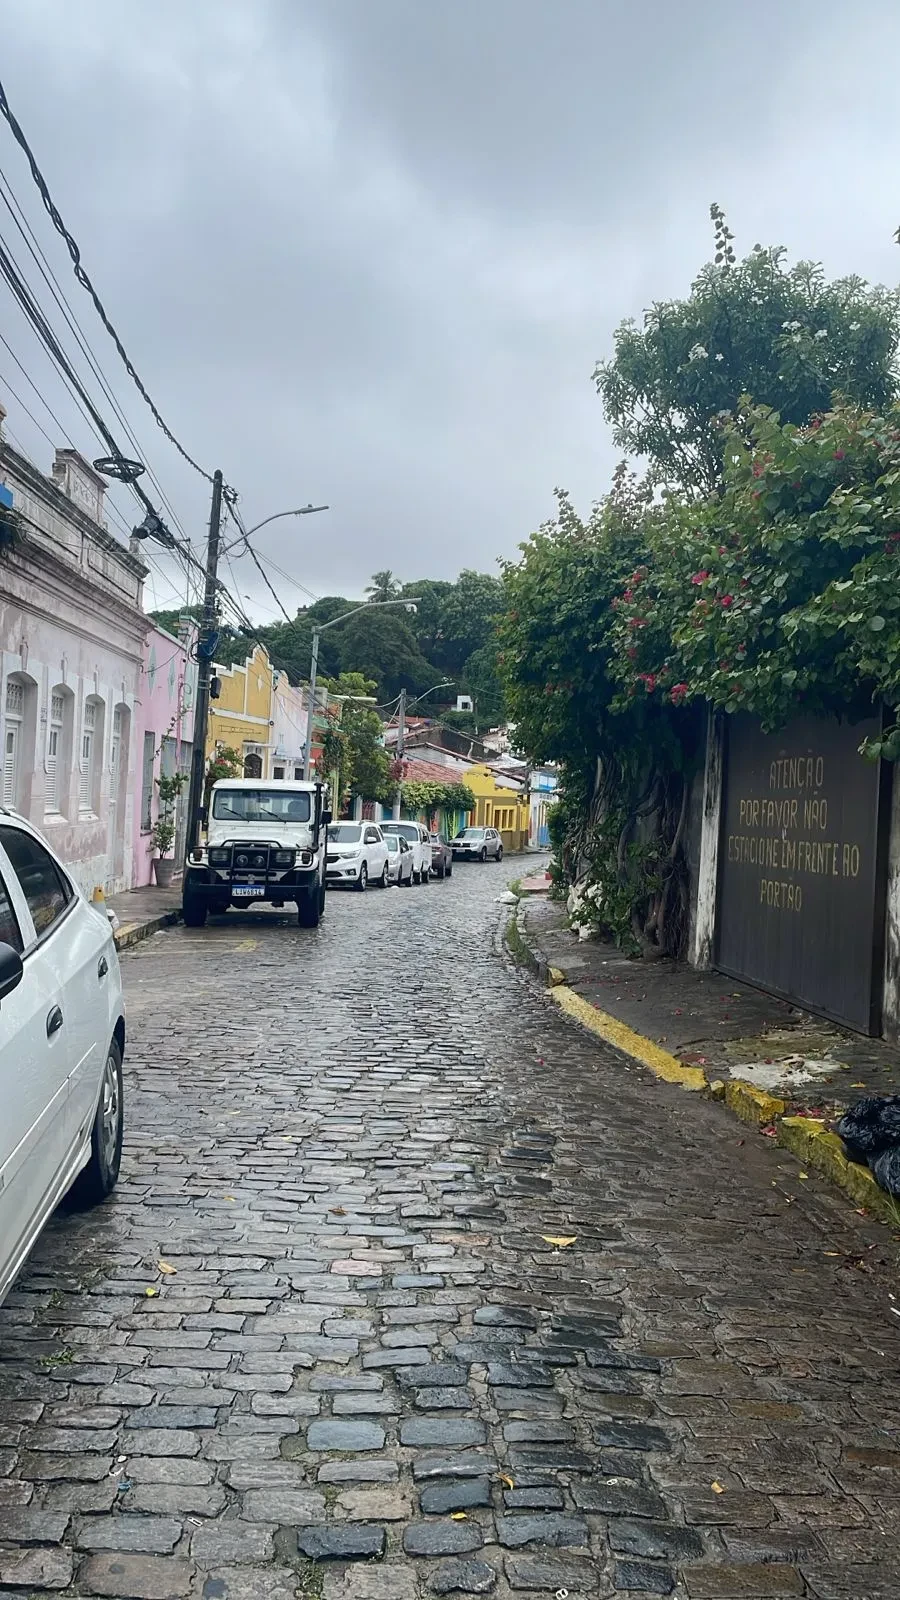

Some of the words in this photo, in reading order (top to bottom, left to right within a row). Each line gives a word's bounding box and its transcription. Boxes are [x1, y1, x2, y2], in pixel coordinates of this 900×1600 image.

[739, 799, 759, 828] POR
[761, 799, 798, 830] FAVOR
[803, 790, 828, 830] NÃO
[728, 835, 779, 868] ESTACIONE
[781, 839, 796, 870] EM
[798, 841, 839, 876] FRENTE
[842, 843, 860, 877] AO
[760, 876, 802, 912] PORTÃO
